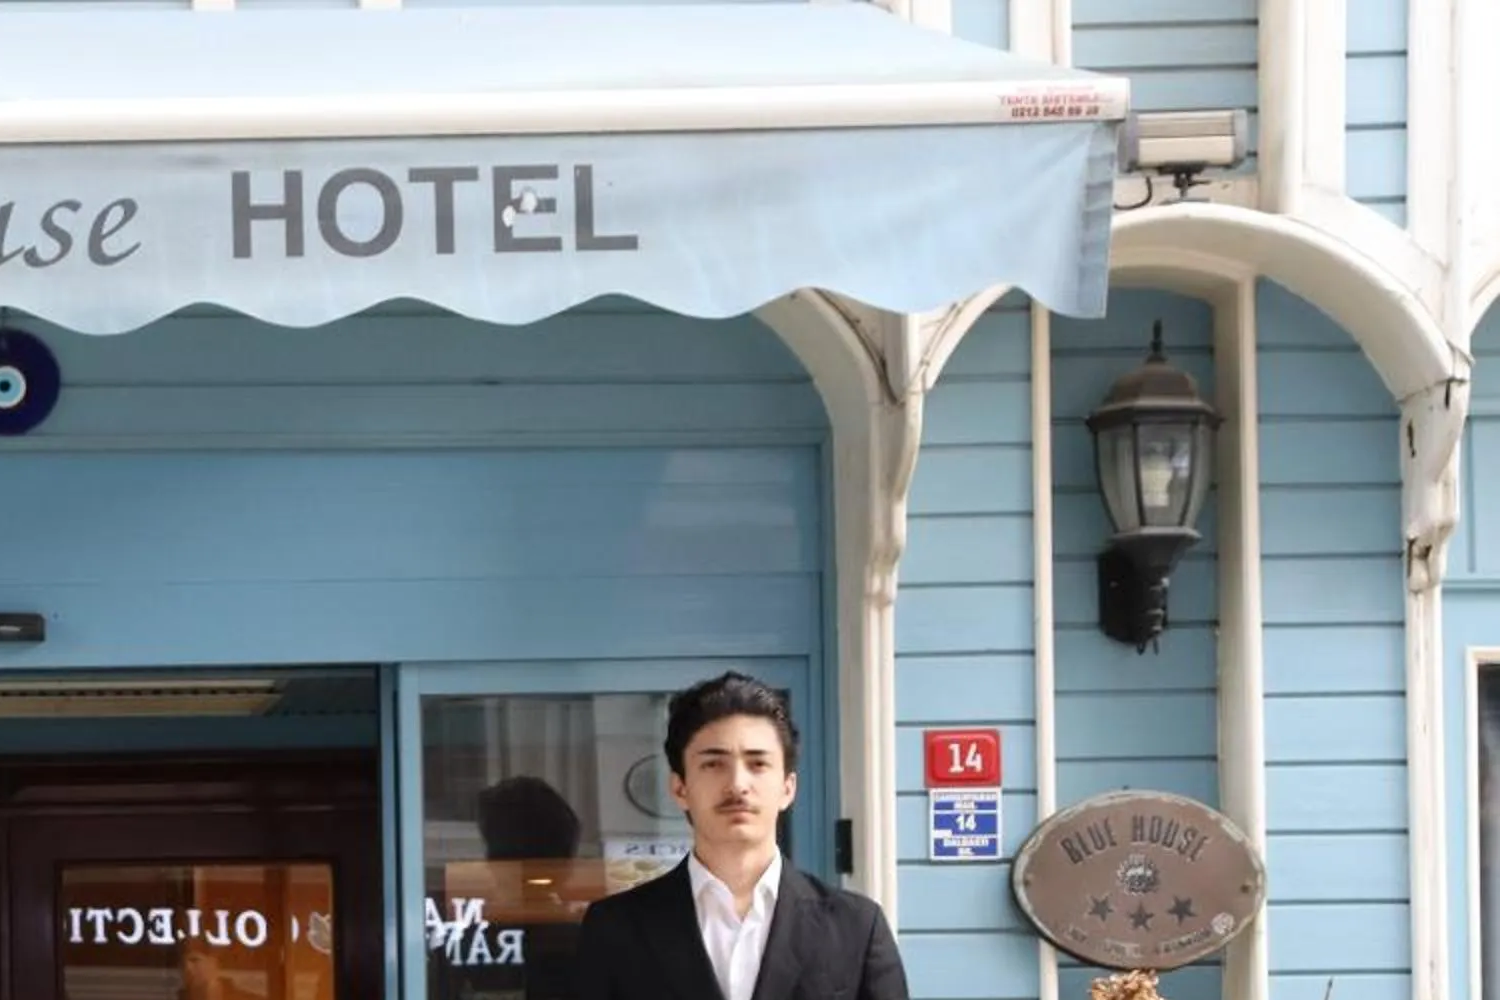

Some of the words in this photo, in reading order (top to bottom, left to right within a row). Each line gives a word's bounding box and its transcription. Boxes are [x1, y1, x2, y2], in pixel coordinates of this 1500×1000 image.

[230, 164, 639, 259] HOTEL
[947, 742, 984, 773] 14
[955, 814, 977, 831] 14
[1060, 816, 1118, 864] BLUE
[1131, 814, 1210, 862] HOUSE
